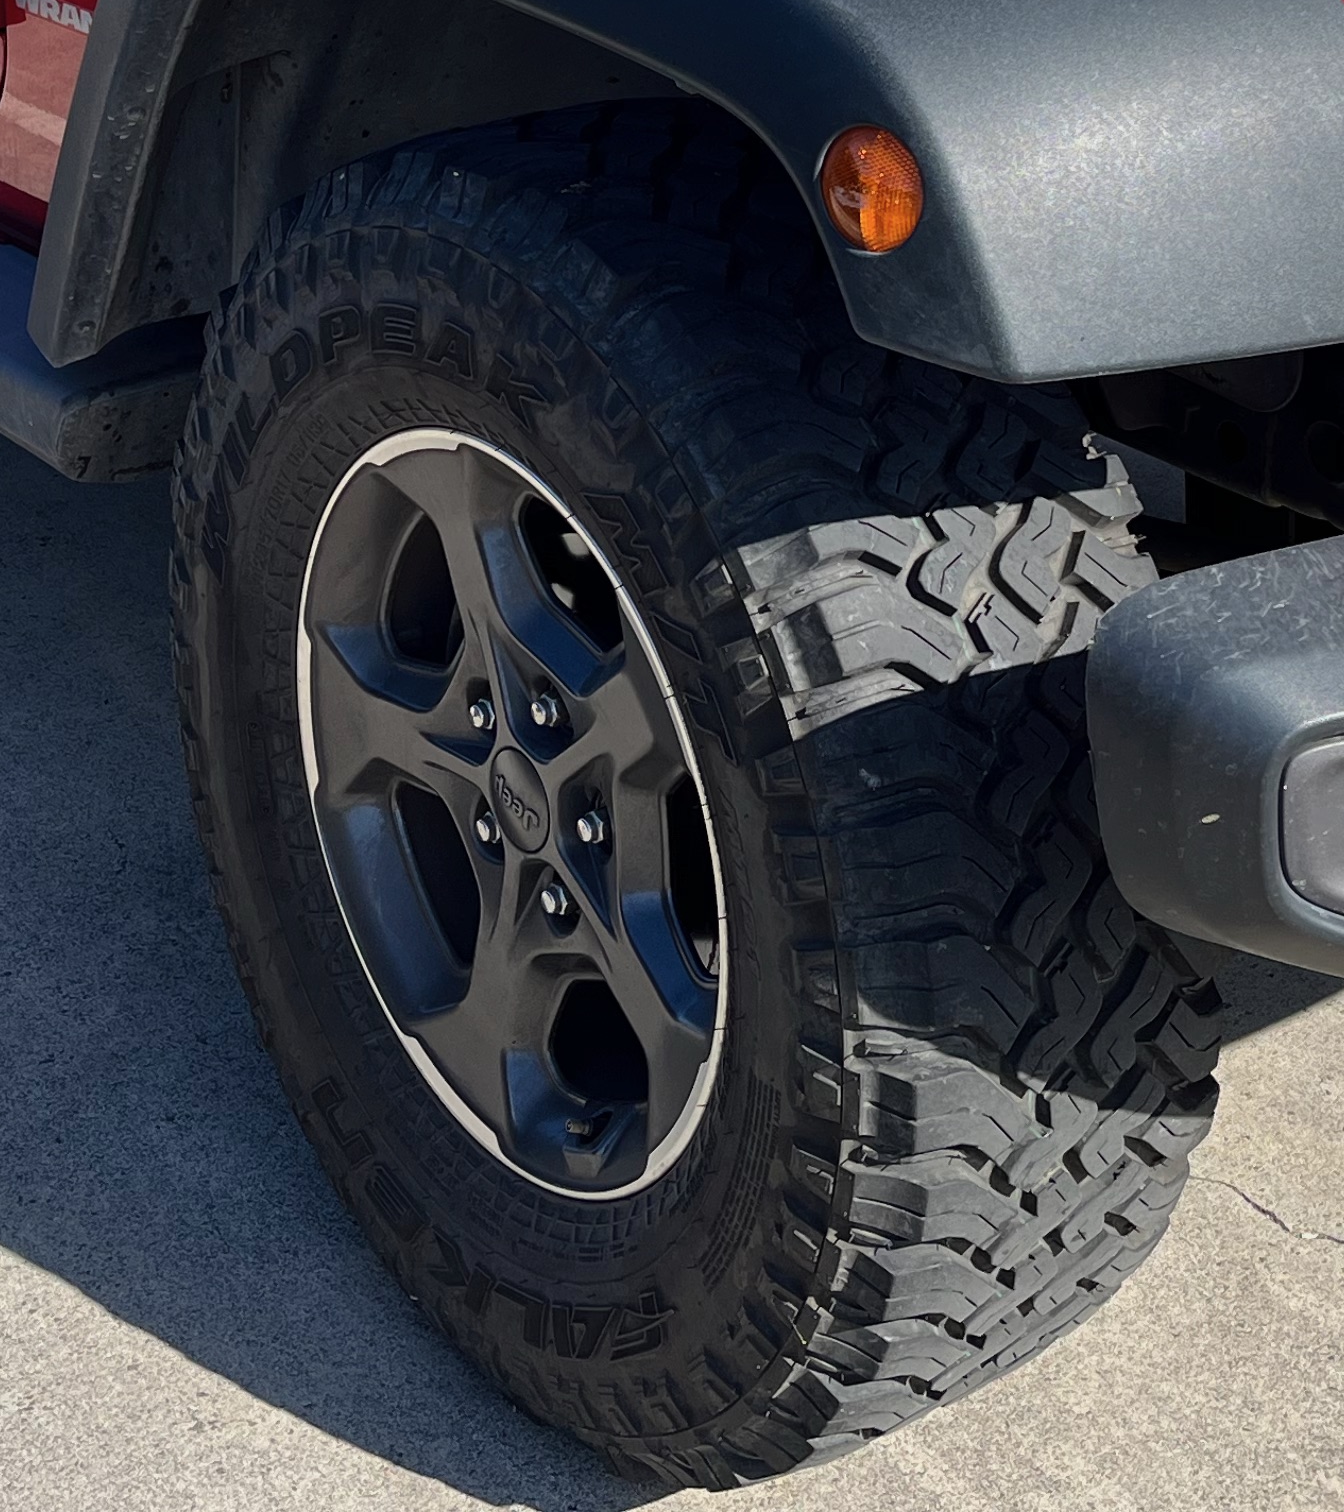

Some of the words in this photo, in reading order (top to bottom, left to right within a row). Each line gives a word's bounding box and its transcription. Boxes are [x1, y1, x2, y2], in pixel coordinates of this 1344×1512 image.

[200, 300, 548, 585] WILDPEAK
[580, 489, 740, 769] M/T
[494, 773, 541, 833] Jeep
[311, 1078, 676, 1361] FALKEN
